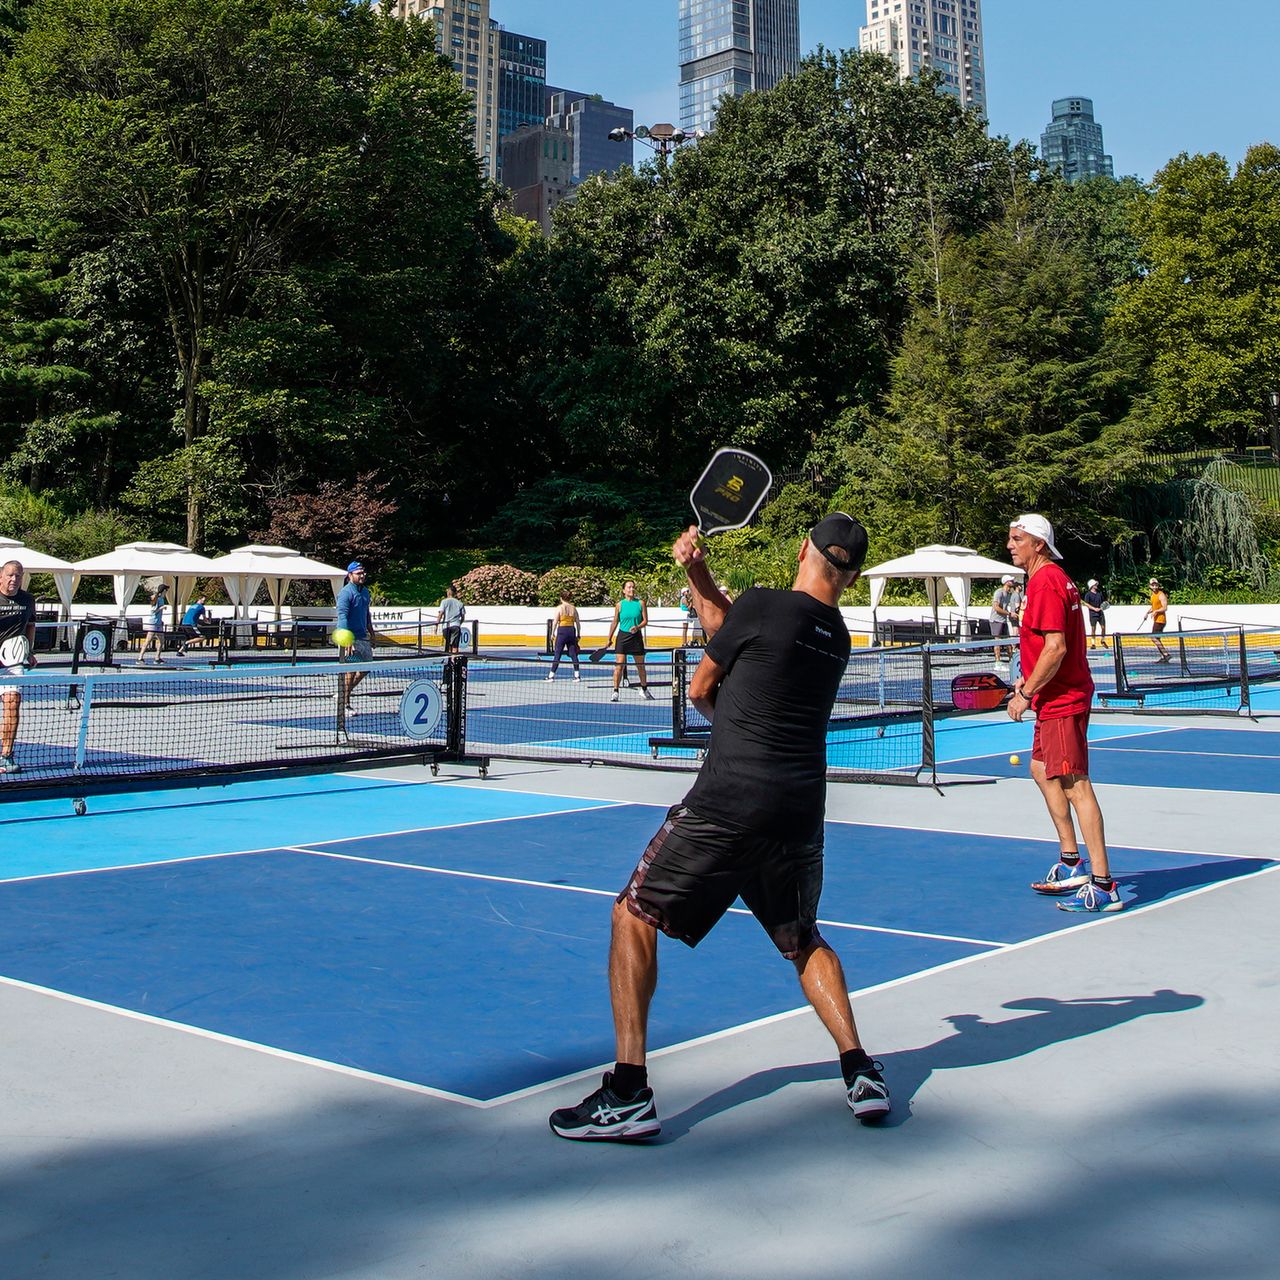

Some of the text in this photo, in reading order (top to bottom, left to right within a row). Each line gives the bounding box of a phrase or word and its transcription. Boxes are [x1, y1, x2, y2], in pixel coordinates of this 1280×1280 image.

[91, 636, 99, 651] 9
[955, 677, 997, 687] SLK
[413, 693, 430, 725] 2
